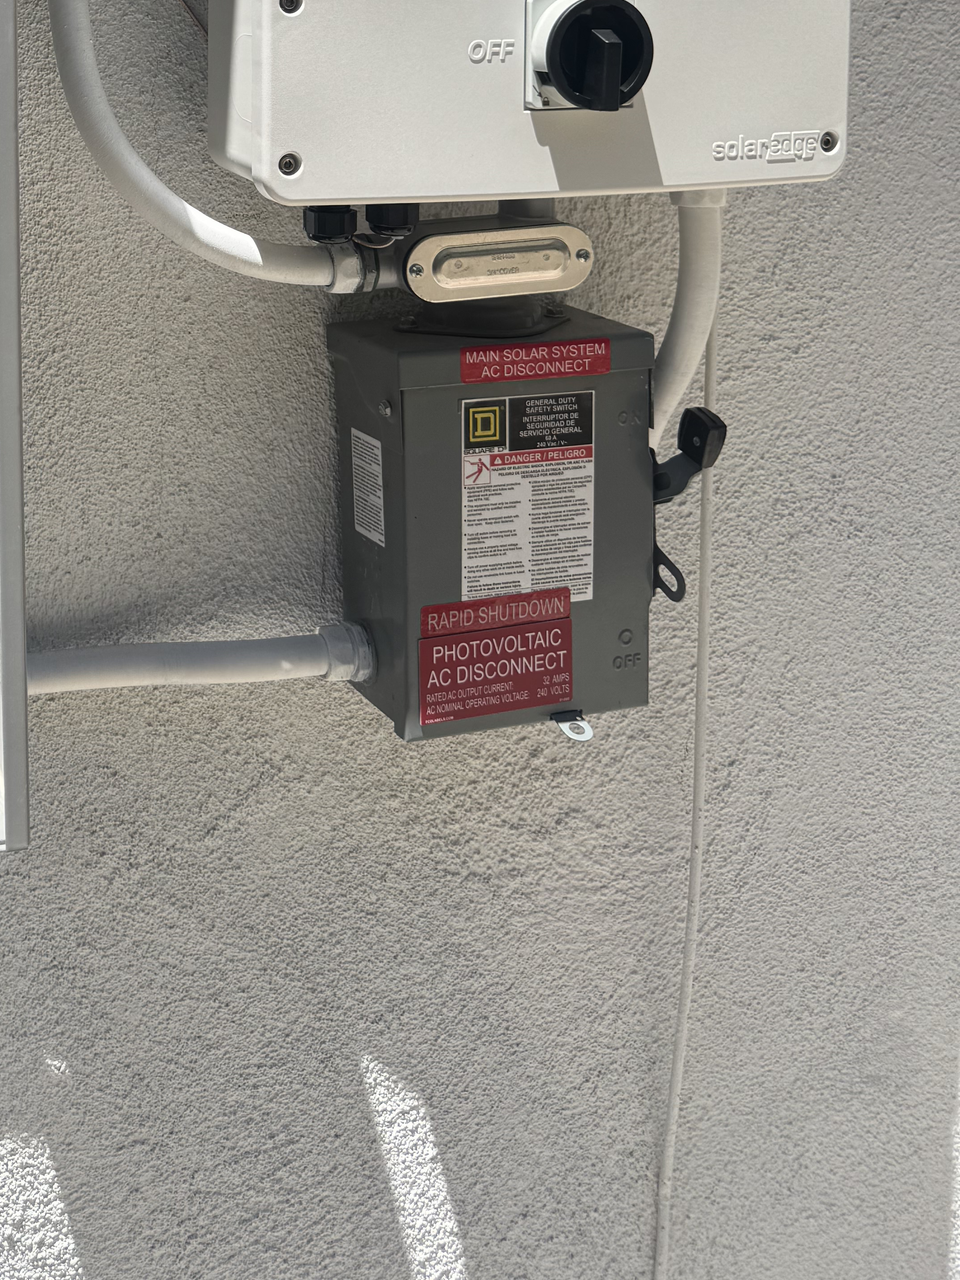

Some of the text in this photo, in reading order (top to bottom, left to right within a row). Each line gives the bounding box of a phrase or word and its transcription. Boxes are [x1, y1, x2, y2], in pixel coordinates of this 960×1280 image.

[468, 39, 515, 63] OFF
[466, 343, 605, 363] MAIN SOLAR SYSTEM
[481, 359, 591, 378] AC DISCONNECT
[526, 398, 557, 406] GENERAL
[504, 452, 540, 463] DANGER
[548, 449, 585, 460] PELIGRO
[428, 597, 564, 631] RAPID SHUTDOWN
[433, 629, 562, 664] PHOTOVOLTAIC
[427, 651, 567, 688] AC DISCONNECT
[612, 653, 641, 670] OFF
[427, 673, 569, 703] RATED AC OUTPUT CURRENT: 32 AMPS
